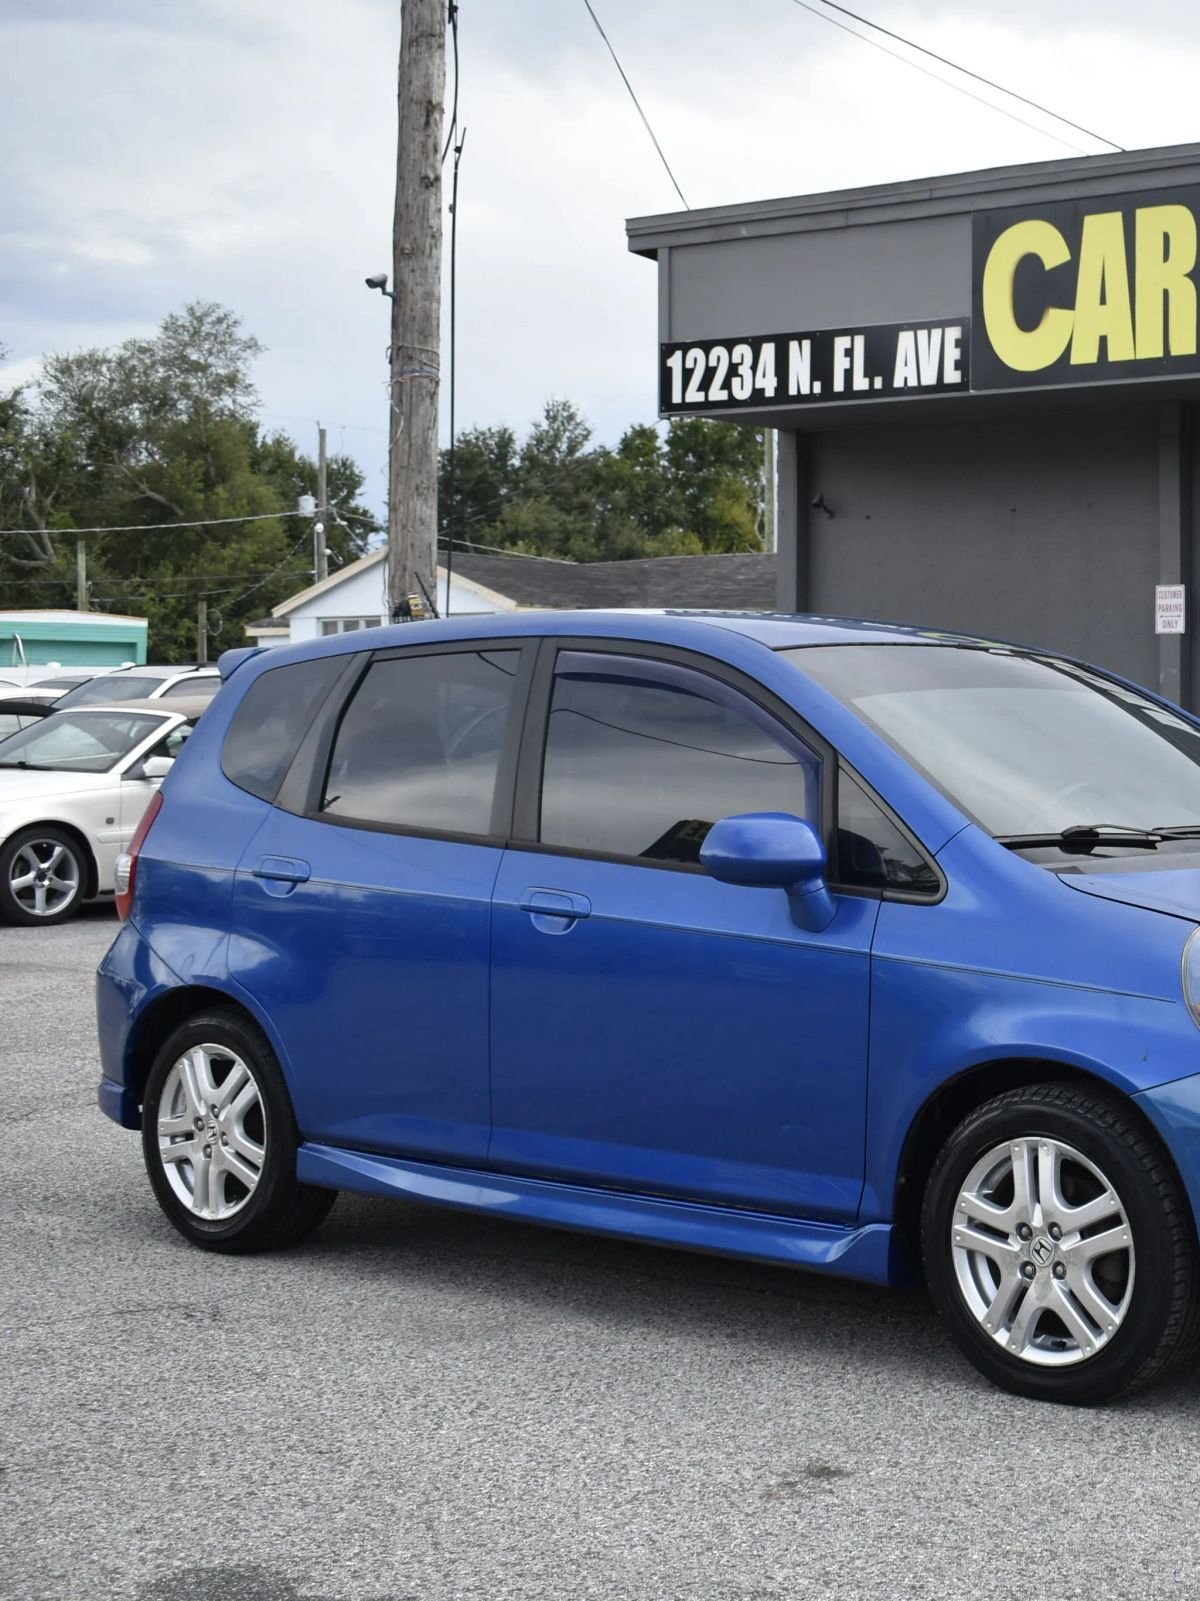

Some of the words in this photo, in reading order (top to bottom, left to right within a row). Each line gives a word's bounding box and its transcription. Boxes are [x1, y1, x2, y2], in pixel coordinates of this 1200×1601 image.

[666, 342, 778, 404] 12234
[788, 339, 822, 396] N.
[833, 334, 883, 393] FL.
[893, 326, 962, 388] AVE
[1158, 590, 1183, 600] CUSTOMER
[1158, 603, 1183, 613] PARKING
[1162, 619, 1178, 629] ONLY
